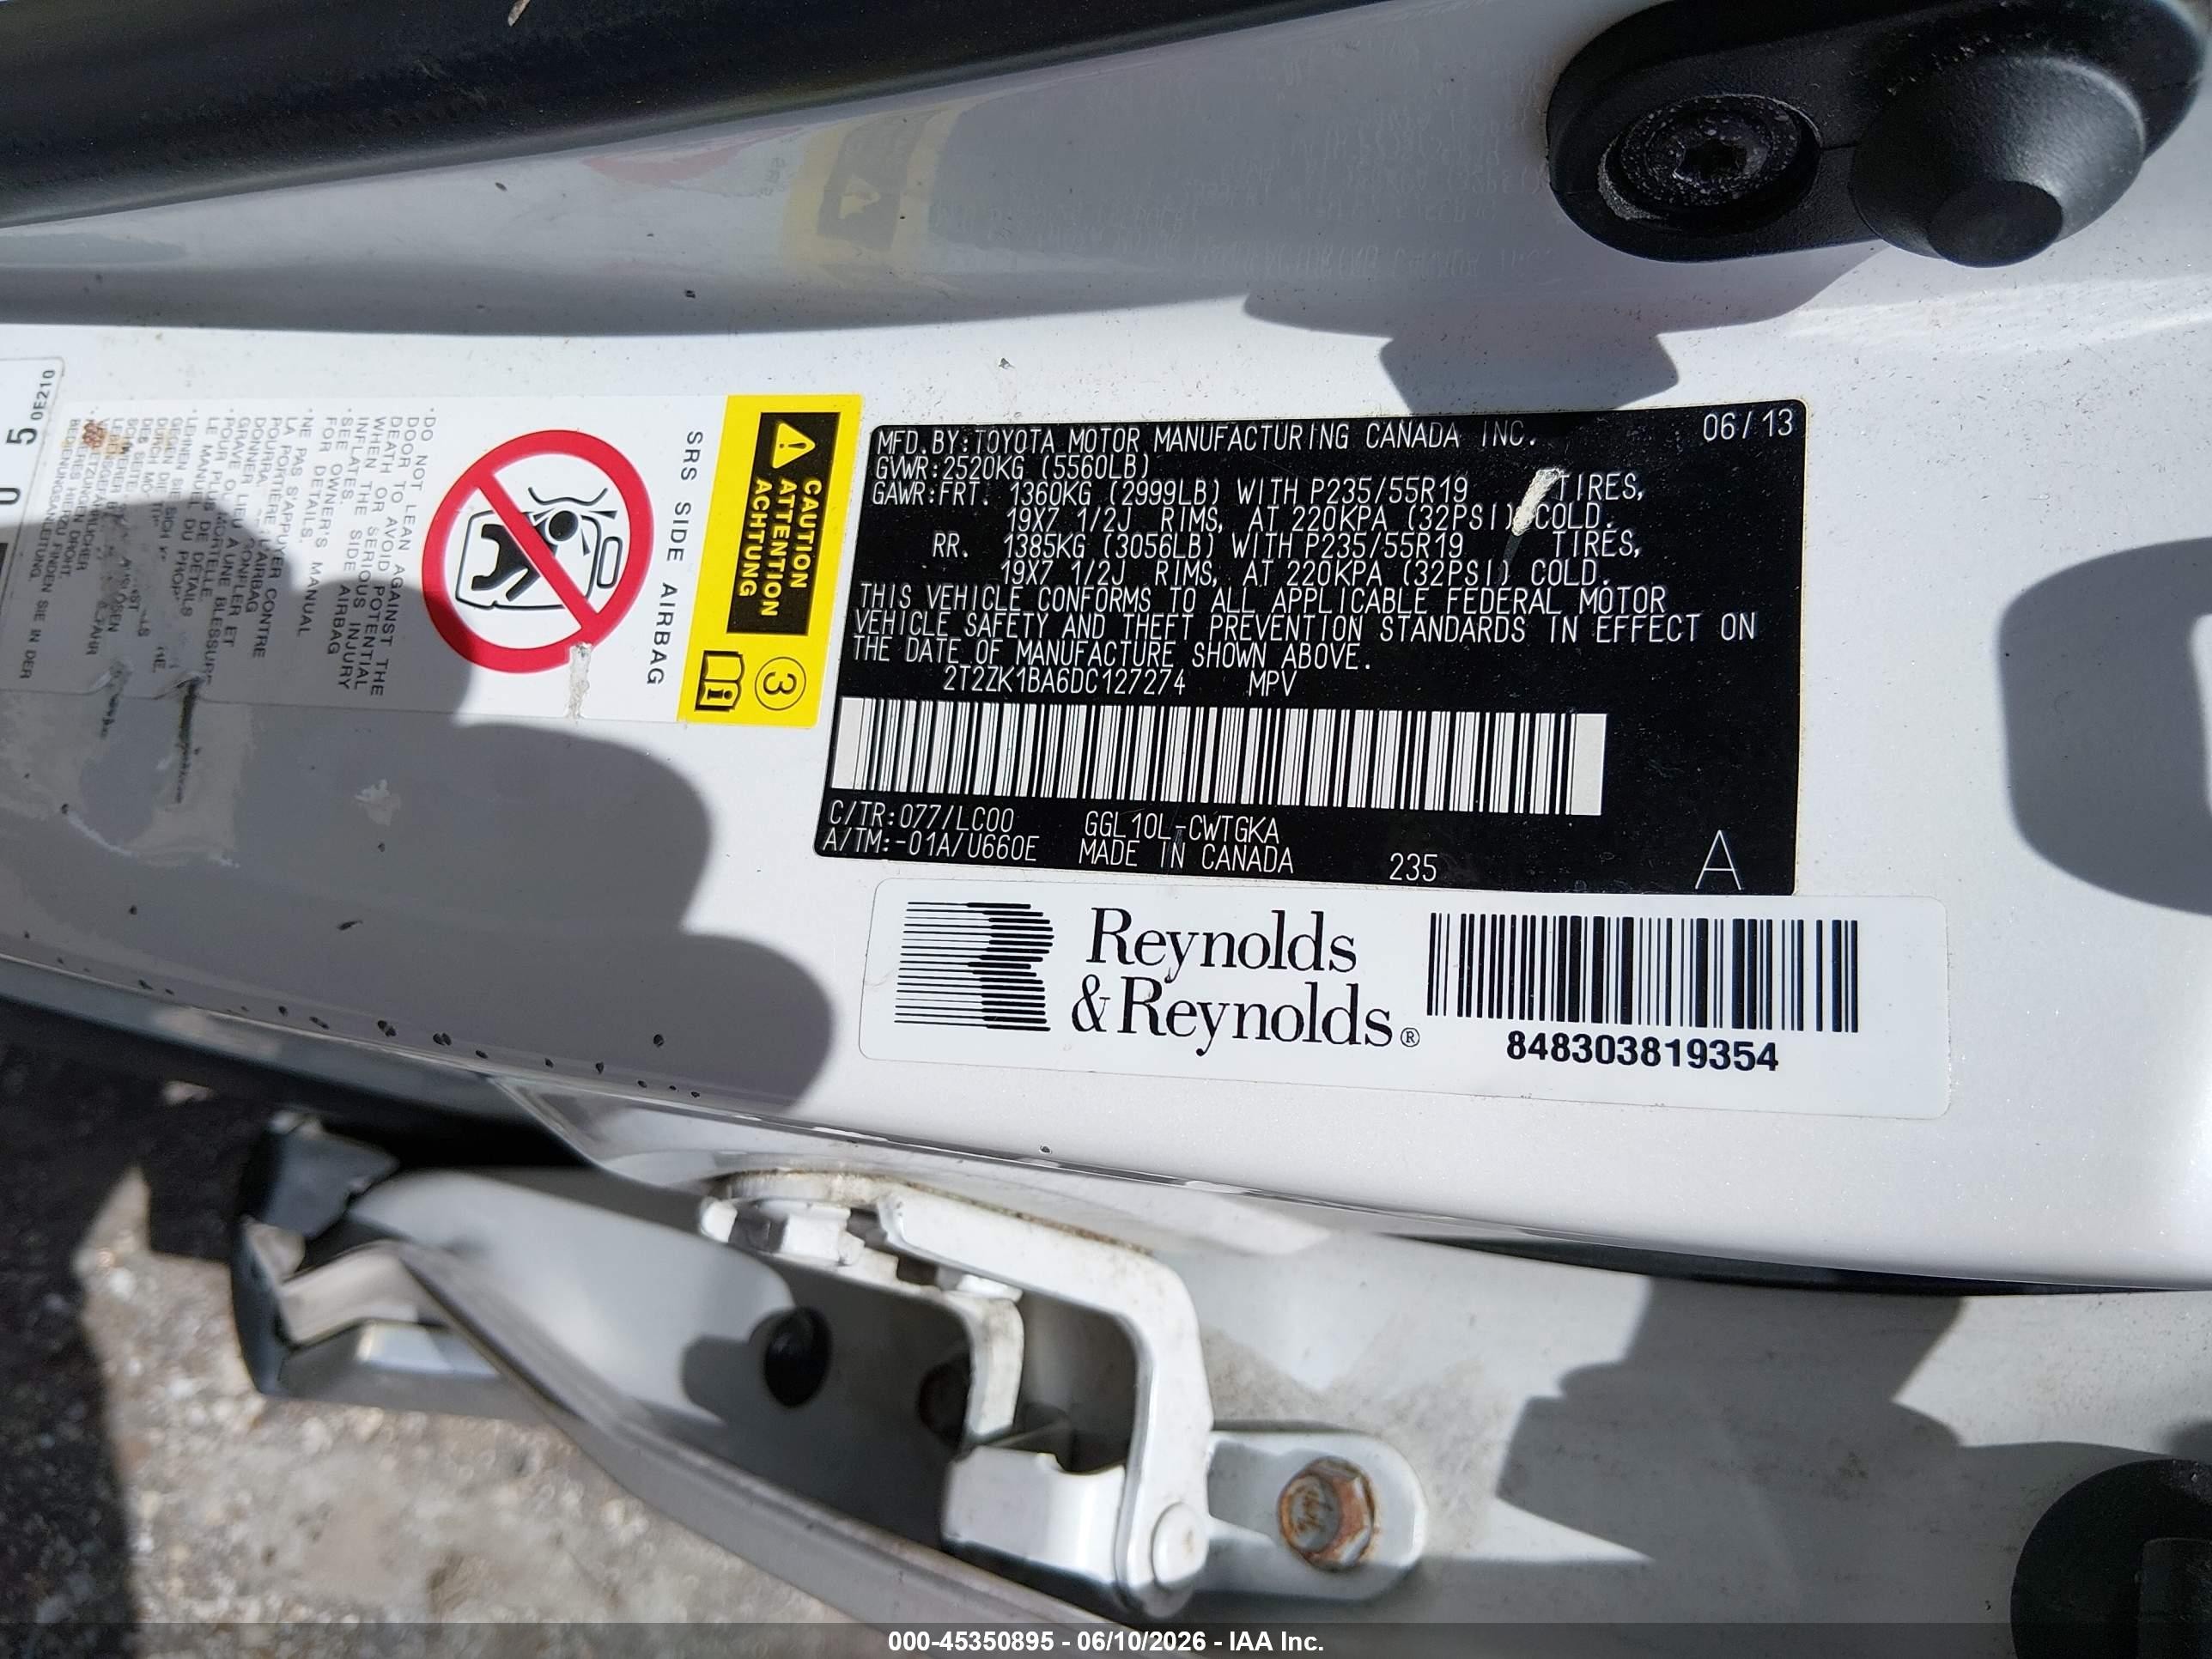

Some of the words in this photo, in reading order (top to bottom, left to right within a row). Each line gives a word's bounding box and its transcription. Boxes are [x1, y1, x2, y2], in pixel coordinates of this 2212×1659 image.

[6, 427, 38, 446] 5
[204, 416, 221, 436] LE
[213, 416, 236, 462] POUR
[227, 416, 252, 471] GRAVE
[297, 416, 315, 439] NE
[317, 416, 338, 453] FOR
[334, 416, 355, 451] SEE
[363, 416, 387, 470] WHEN
[380, 416, 404, 475] DEATH
[397, 416, 421, 470] DOOR
[420, 416, 437, 442] DO
[1067, 425, 1140, 455] MOTOR
[1153, 421, 1350, 453] MANUFACTURING
[1365, 420, 1461, 449] CANADA
[1481, 420, 1537, 447] INC.
[1703, 407, 1795, 442] 06/13
[239, 416, 267, 485] DONNER
[289, 447, 308, 477] PAS
[338, 416, 370, 506] INFLATES.
[680, 430, 704, 482] SRS
[1038, 452, 1149, 482] (5560LB)
[389, 480, 407, 504] TO
[409, 454, 429, 492] NOT
[1009, 480, 1092, 507] 1360KG
[1106, 478, 1220, 507] (2999LB)
[1237, 477, 1298, 506] WITH
[1310, 476, 1469, 506] P235/55R19
[1555, 471, 1645, 502] TIRES,
[228, 493, 250, 530] LIEU
[298, 465, 328, 544] DETAILS.
[314, 463, 345, 550] OWNER'S
[353, 480, 374, 517] THE
[371, 486, 389, 514] OR
[1006, 507, 1060, 533] 19X7
[1075, 507, 1132, 533] 1/2J
[1160, 507, 1224, 535] RIMS,
[1248, 505, 1280, 532] AT
[1290, 504, 1388, 533] 220KPA
[1407, 502, 1514, 532] (32PSI)
[1534, 501, 1613, 531] COLD.
[179, 518, 197, 543] DU
[194, 520, 213, 544] DE
[376, 515, 400, 573] AVOID
[396, 504, 419, 552] LEAN
[666, 501, 692, 562] SIDE
[738, 478, 774, 598] ACHTUNG
[760, 479, 799, 617] ATTENTION
[790, 479, 823, 590] CAUTION
[932, 532, 969, 558] RR.
[1003, 532, 1086, 560] 1385KG
[1101, 532, 1214, 560] (3056LB)
[1231, 531, 1294, 559] WITH
[1304, 531, 1464, 559] P235/55R19
[1552, 528, 1643, 559] TIRES,
[342, 529, 364, 573] SIDE
[351, 525, 381, 610] SERIOUS
[1000, 559, 1054, 586] 19X7
[1070, 559, 1127, 586] 1/2J
[1154, 559, 1218, 588] RIMS,
[1242, 560, 1274, 586] AT
[1285, 559, 1382, 587] 220KPA
[1402, 559, 1510, 588] (32PSI)
[1530, 558, 1611, 587] COLD.
[295, 562, 324, 640] MANUAL
[325, 582, 353, 657] AIRBAG
[378, 562, 408, 647] AGAINST
[854, 581, 912, 611] THIS
[927, 583, 1024, 612] VEHICLE
[1037, 585, 1152, 614] CONFORMS
[1169, 586, 1197, 614] TO
[1210, 586, 1256, 615] ALL
[1270, 586, 1431, 616] APPLICABLE
[1446, 586, 1563, 616] FEDERAL
[1578, 584, 1668, 616] MOTOR
[221, 625, 239, 648] ET
[251, 586, 280, 659] CONTRE
[353, 584, 387, 692] POTENTIAL
[647, 582, 678, 686] AIRBAG
[853, 609, 951, 637] VEHICLE
[964, 611, 1049, 639] SAFETY
[1060, 612, 1106, 640] AND
[1122, 612, 1193, 641] THEFT
[1208, 613, 1364, 642] PREVENTION
[1379, 614, 1526, 644] STANDARDS
[1550, 614, 1579, 644] IN
[1595, 614, 1701, 644] EFFECT
[1720, 611, 1756, 641] ON
[336, 621, 362, 690] INJURY
[853, 634, 893, 663] THE
[904, 635, 963, 665] DATE
[975, 638, 1004, 666] OF
[1015, 638, 1177, 668] MANUFACTURE
[1191, 641, 1267, 670] SHOWN
[1280, 641, 1370, 671] ABOVE.
[369, 657, 391, 698] THE
[762, 671, 798, 700] 3
[942, 665, 1186, 696] 2T2ZK1BA6DC127274
[1246, 669, 1298, 698] MPV
[1078, 837, 1140, 866] MADE
[1160, 840, 1186, 868] IN
[1201, 842, 1294, 873] CANADA
[1389, 852, 1438, 880] 235
[1696, 829, 1745, 890] A
[1085, 906, 1358, 983] Reynolds
[1506, 1029, 1779, 1073] 848303819354
